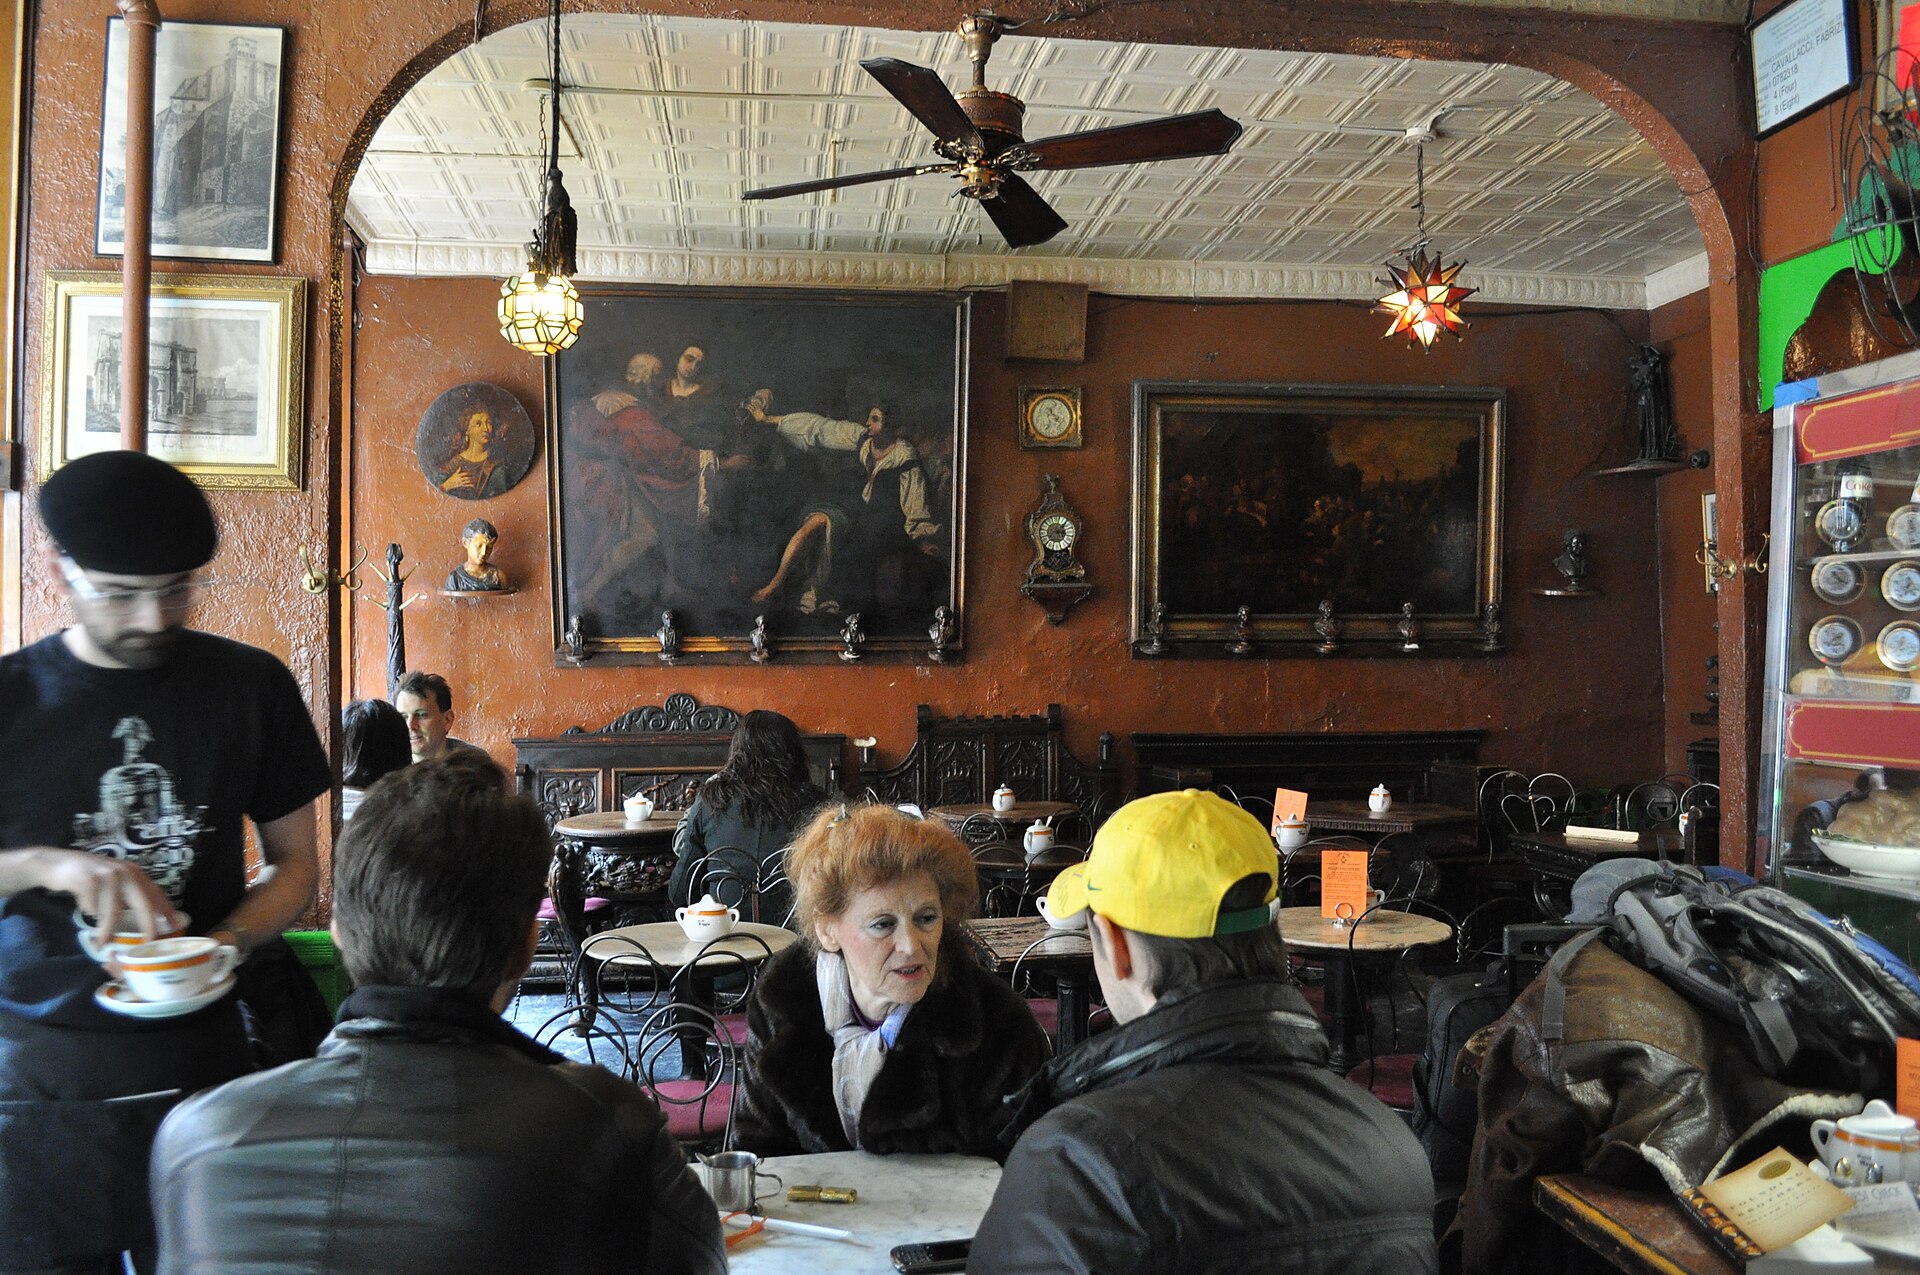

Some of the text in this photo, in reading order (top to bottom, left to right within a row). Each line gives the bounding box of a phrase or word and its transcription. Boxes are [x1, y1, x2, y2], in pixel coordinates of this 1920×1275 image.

[1771, 40, 1815, 73] CAVALLACCI,
[1772, 63, 1799, 87] 0782318
[1778, 79, 1798, 99] (Four)
[1774, 104, 1779, 115] 8
[1779, 93, 1800, 114] (Eight)
[1845, 480, 1872, 492] Coke
